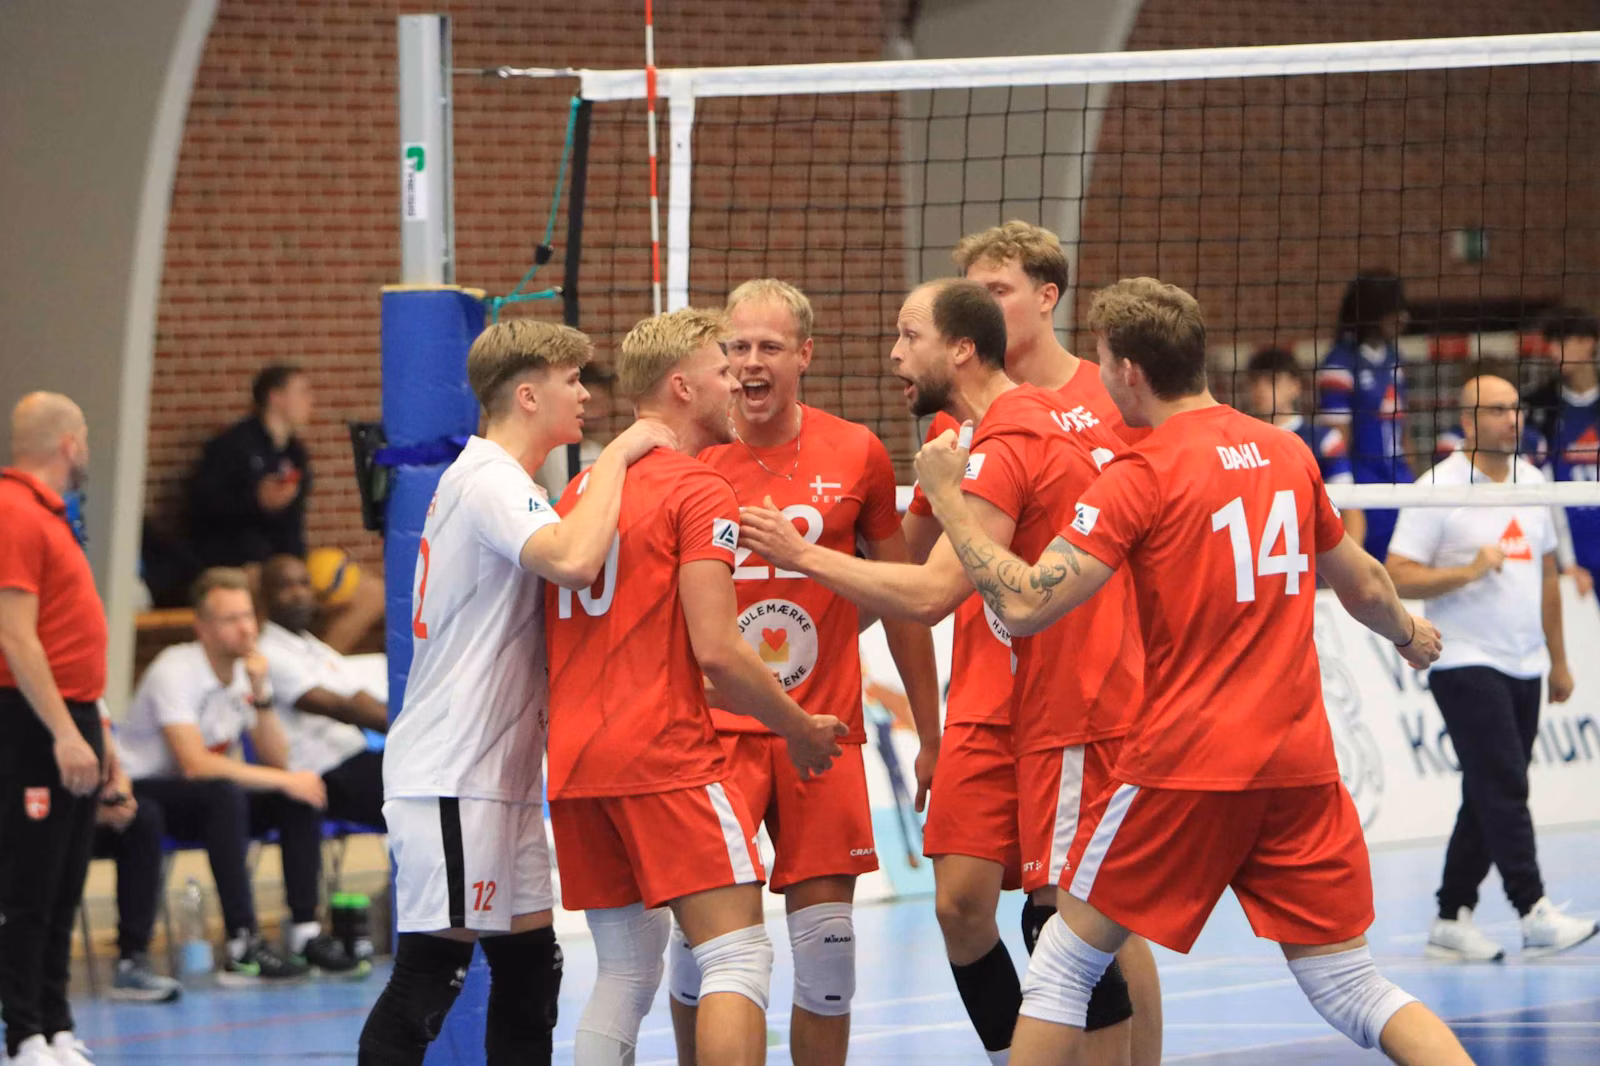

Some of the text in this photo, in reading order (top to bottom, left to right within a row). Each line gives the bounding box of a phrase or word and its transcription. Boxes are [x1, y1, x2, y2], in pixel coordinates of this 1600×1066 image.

[1215, 441, 1271, 470] DAHL
[811, 495, 842, 503] DEN
[1211, 489, 1309, 603] 14
[738, 604, 811, 633] JULEMÆRKE
[472, 880, 497, 911] 12
